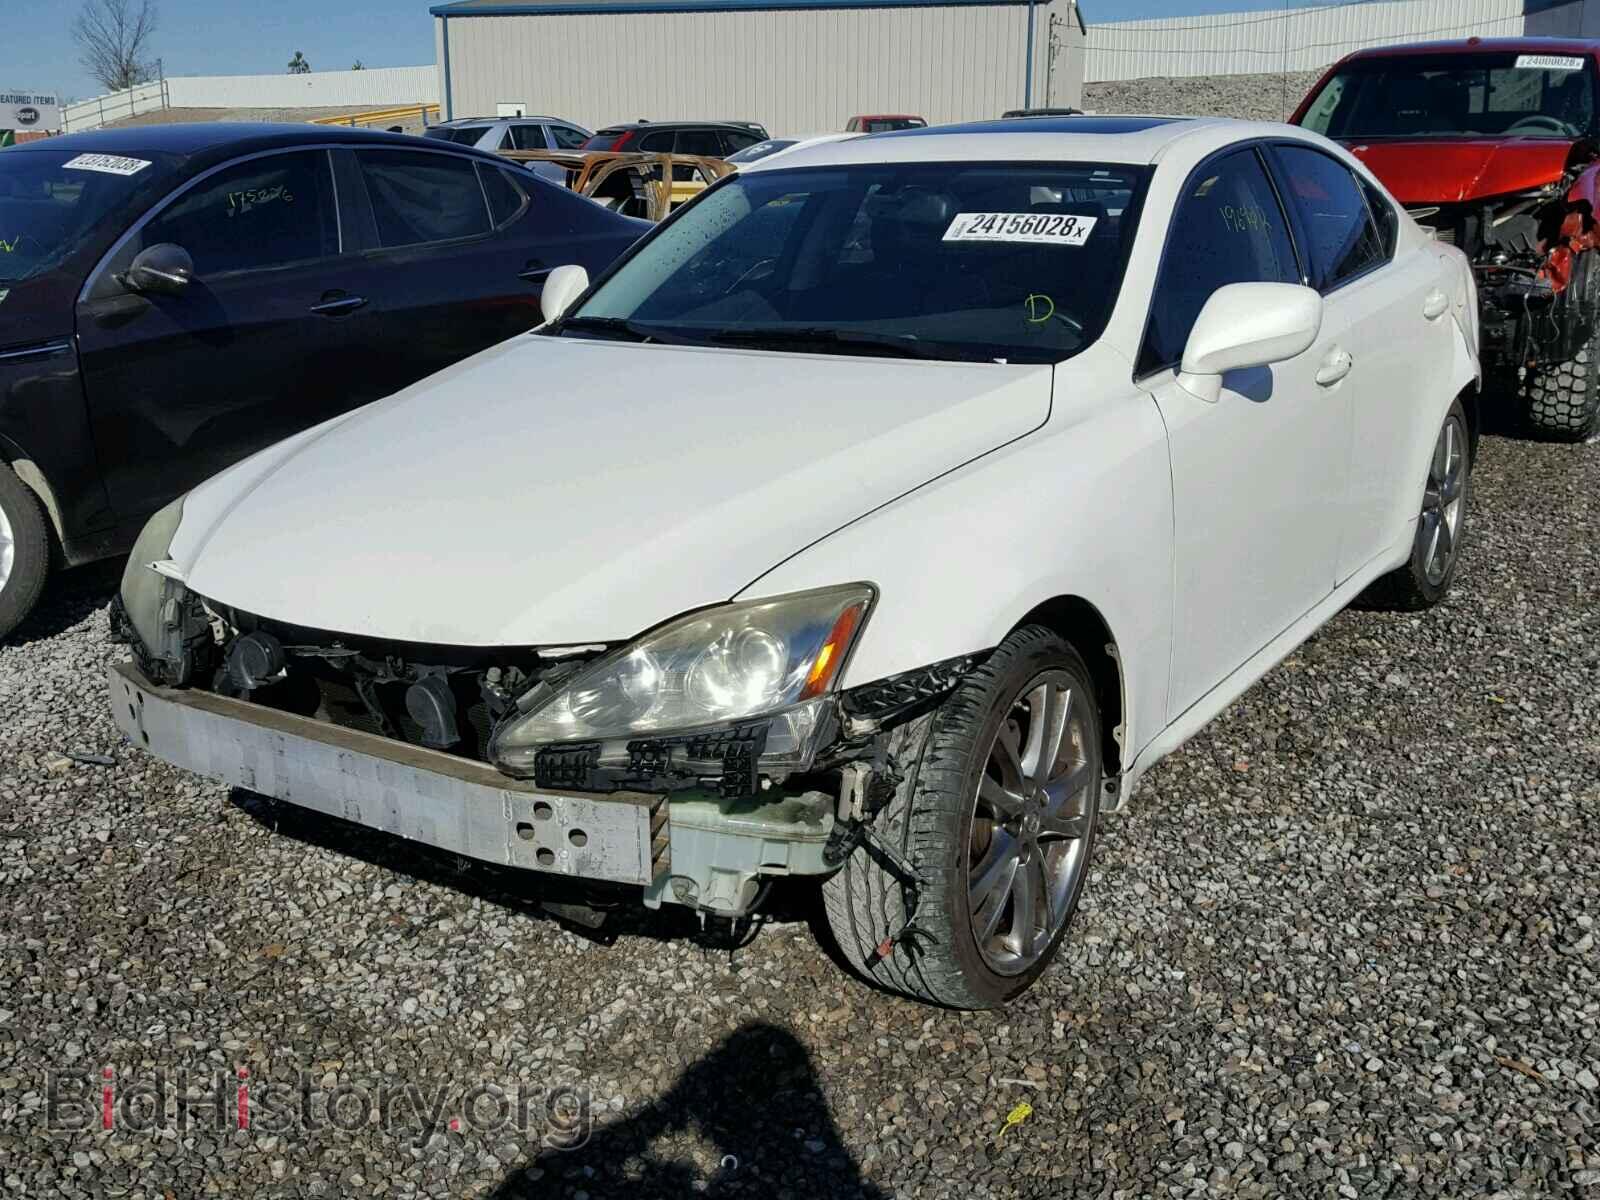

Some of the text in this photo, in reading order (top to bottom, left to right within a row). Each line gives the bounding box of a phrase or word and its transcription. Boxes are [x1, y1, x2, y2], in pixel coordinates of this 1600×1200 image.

[0, 94, 55, 106] EATURED ITEMS
[1025, 293, 1055, 322] D
